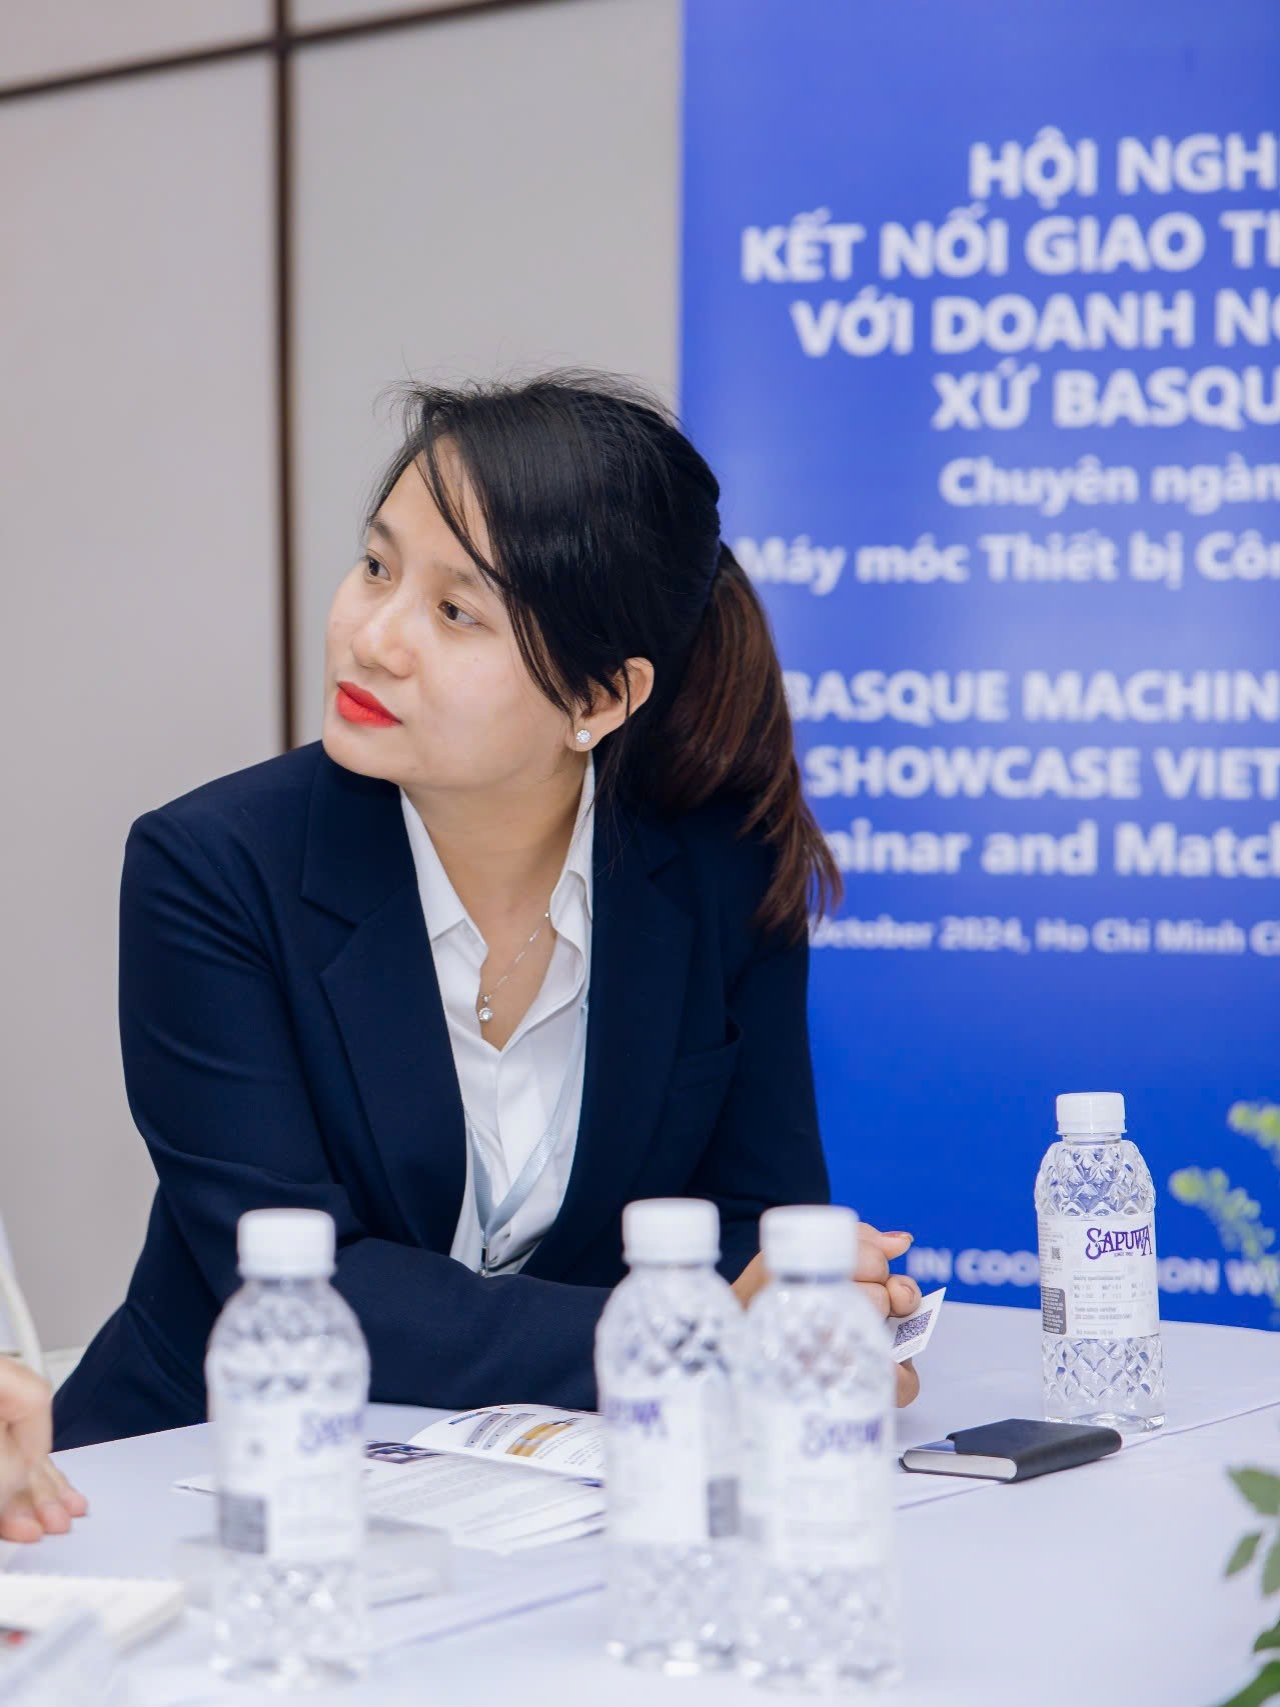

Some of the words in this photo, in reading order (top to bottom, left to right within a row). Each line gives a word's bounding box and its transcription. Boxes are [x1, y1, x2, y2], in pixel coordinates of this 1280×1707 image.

[970, 127, 1097, 209] HỘI
[741, 207, 865, 283] KẾT
[880, 201, 1008, 278] NỐI
[1024, 212, 1205, 274] GIAO
[790, 286, 914, 357] VỚI
[931, 290, 1195, 353] DOANH
[1215, 287, 1280, 347] N
[932, 358, 1041, 430] XỨ
[1052, 366, 1280, 430] BASQU
[939, 454, 1138, 516] Chuyên
[735, 533, 847, 596] Máy
[856, 532, 970, 584] móc
[782, 669, 1010, 728] BASQUE
[1022, 669, 1280, 723] MACHIN
[804, 746, 1141, 799] SHOWCASE
[1152, 747, 1280, 799] VIET
[980, 818, 1098, 875] and
[1085, 1225, 1152, 1260] SAPUWA
